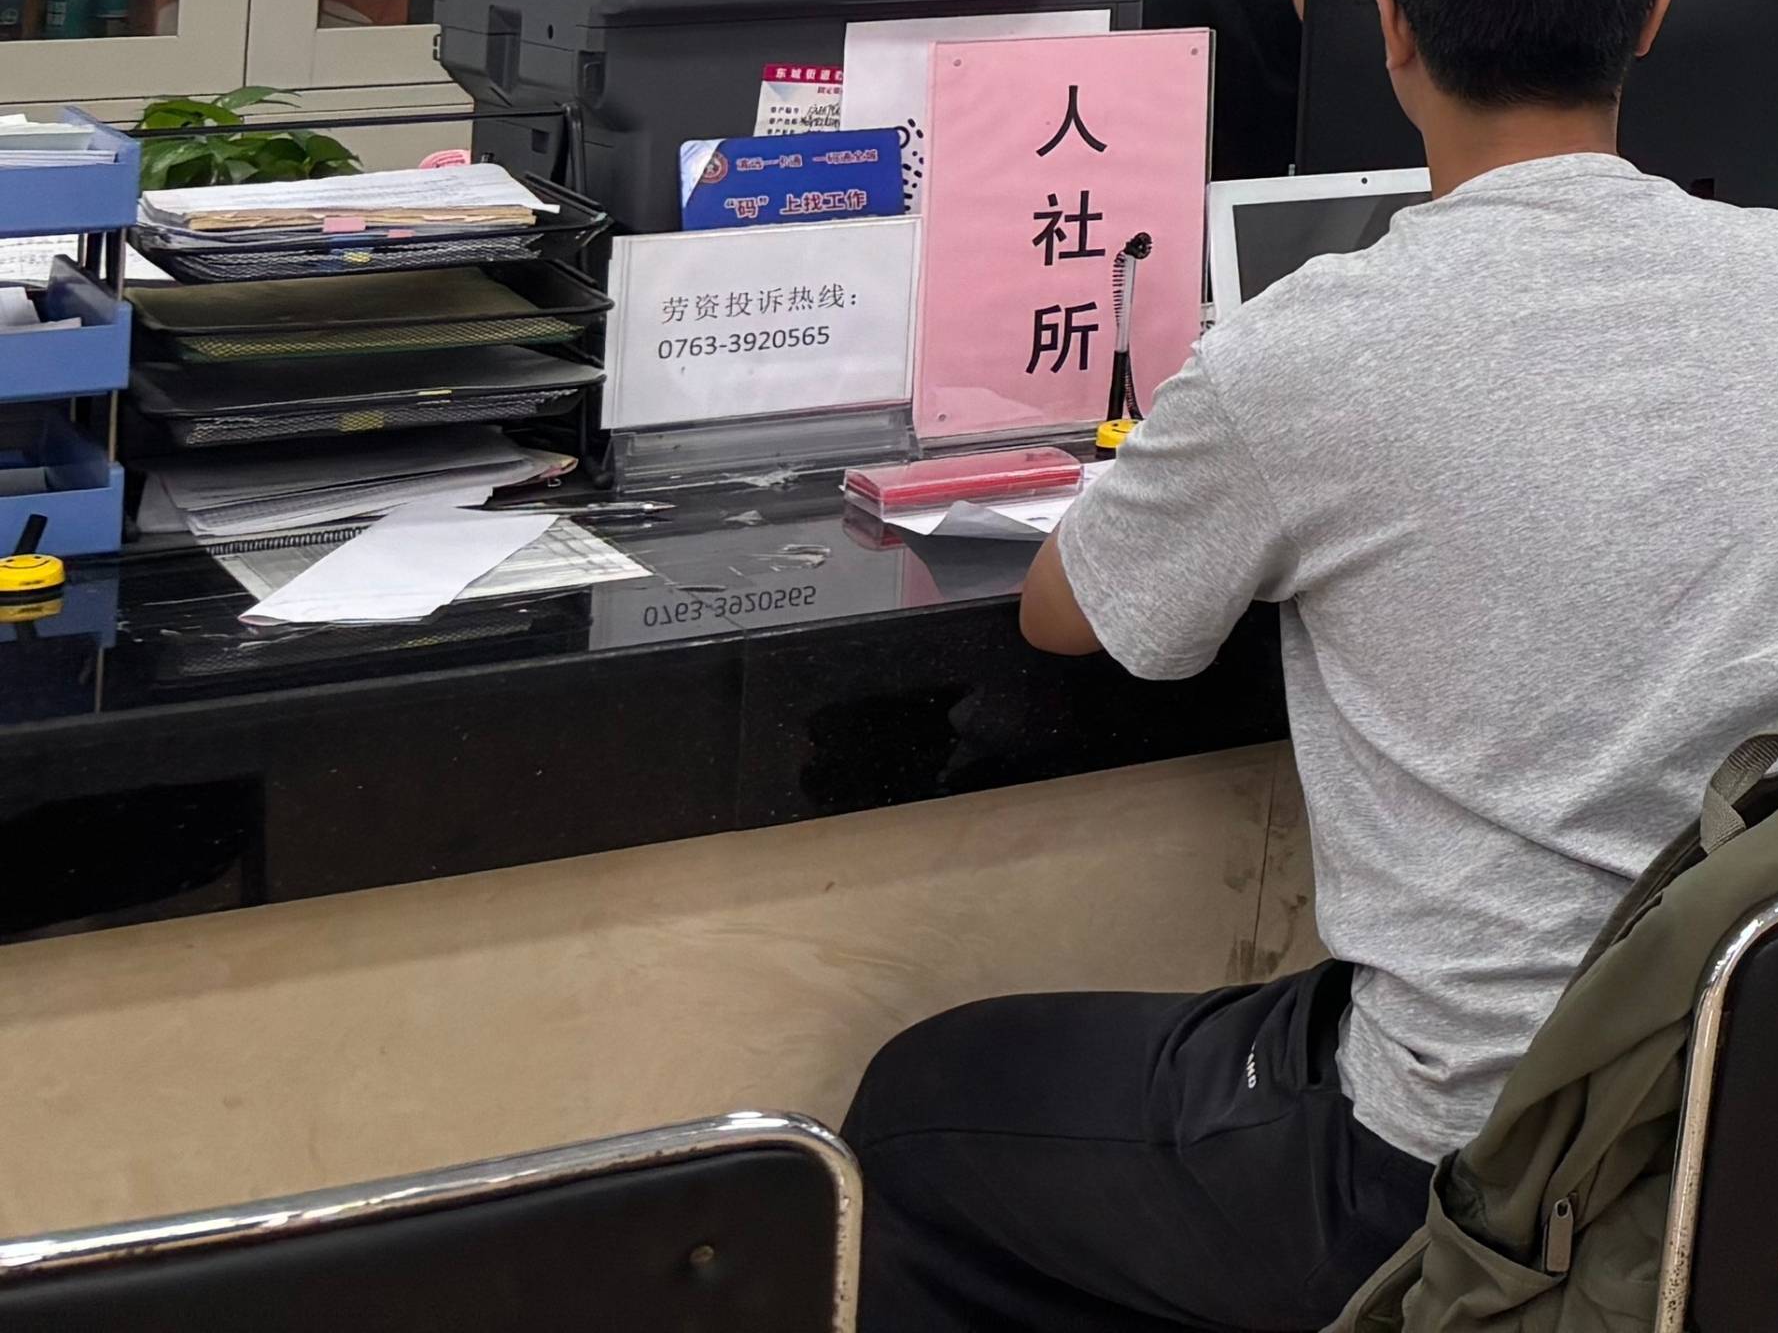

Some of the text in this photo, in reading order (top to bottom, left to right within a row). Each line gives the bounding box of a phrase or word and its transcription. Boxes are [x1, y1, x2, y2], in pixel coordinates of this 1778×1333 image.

[779, 188, 868, 217] 上找工作
[1025, 84, 1109, 376] 人社所
[658, 326, 830, 359] 0763-3920565
